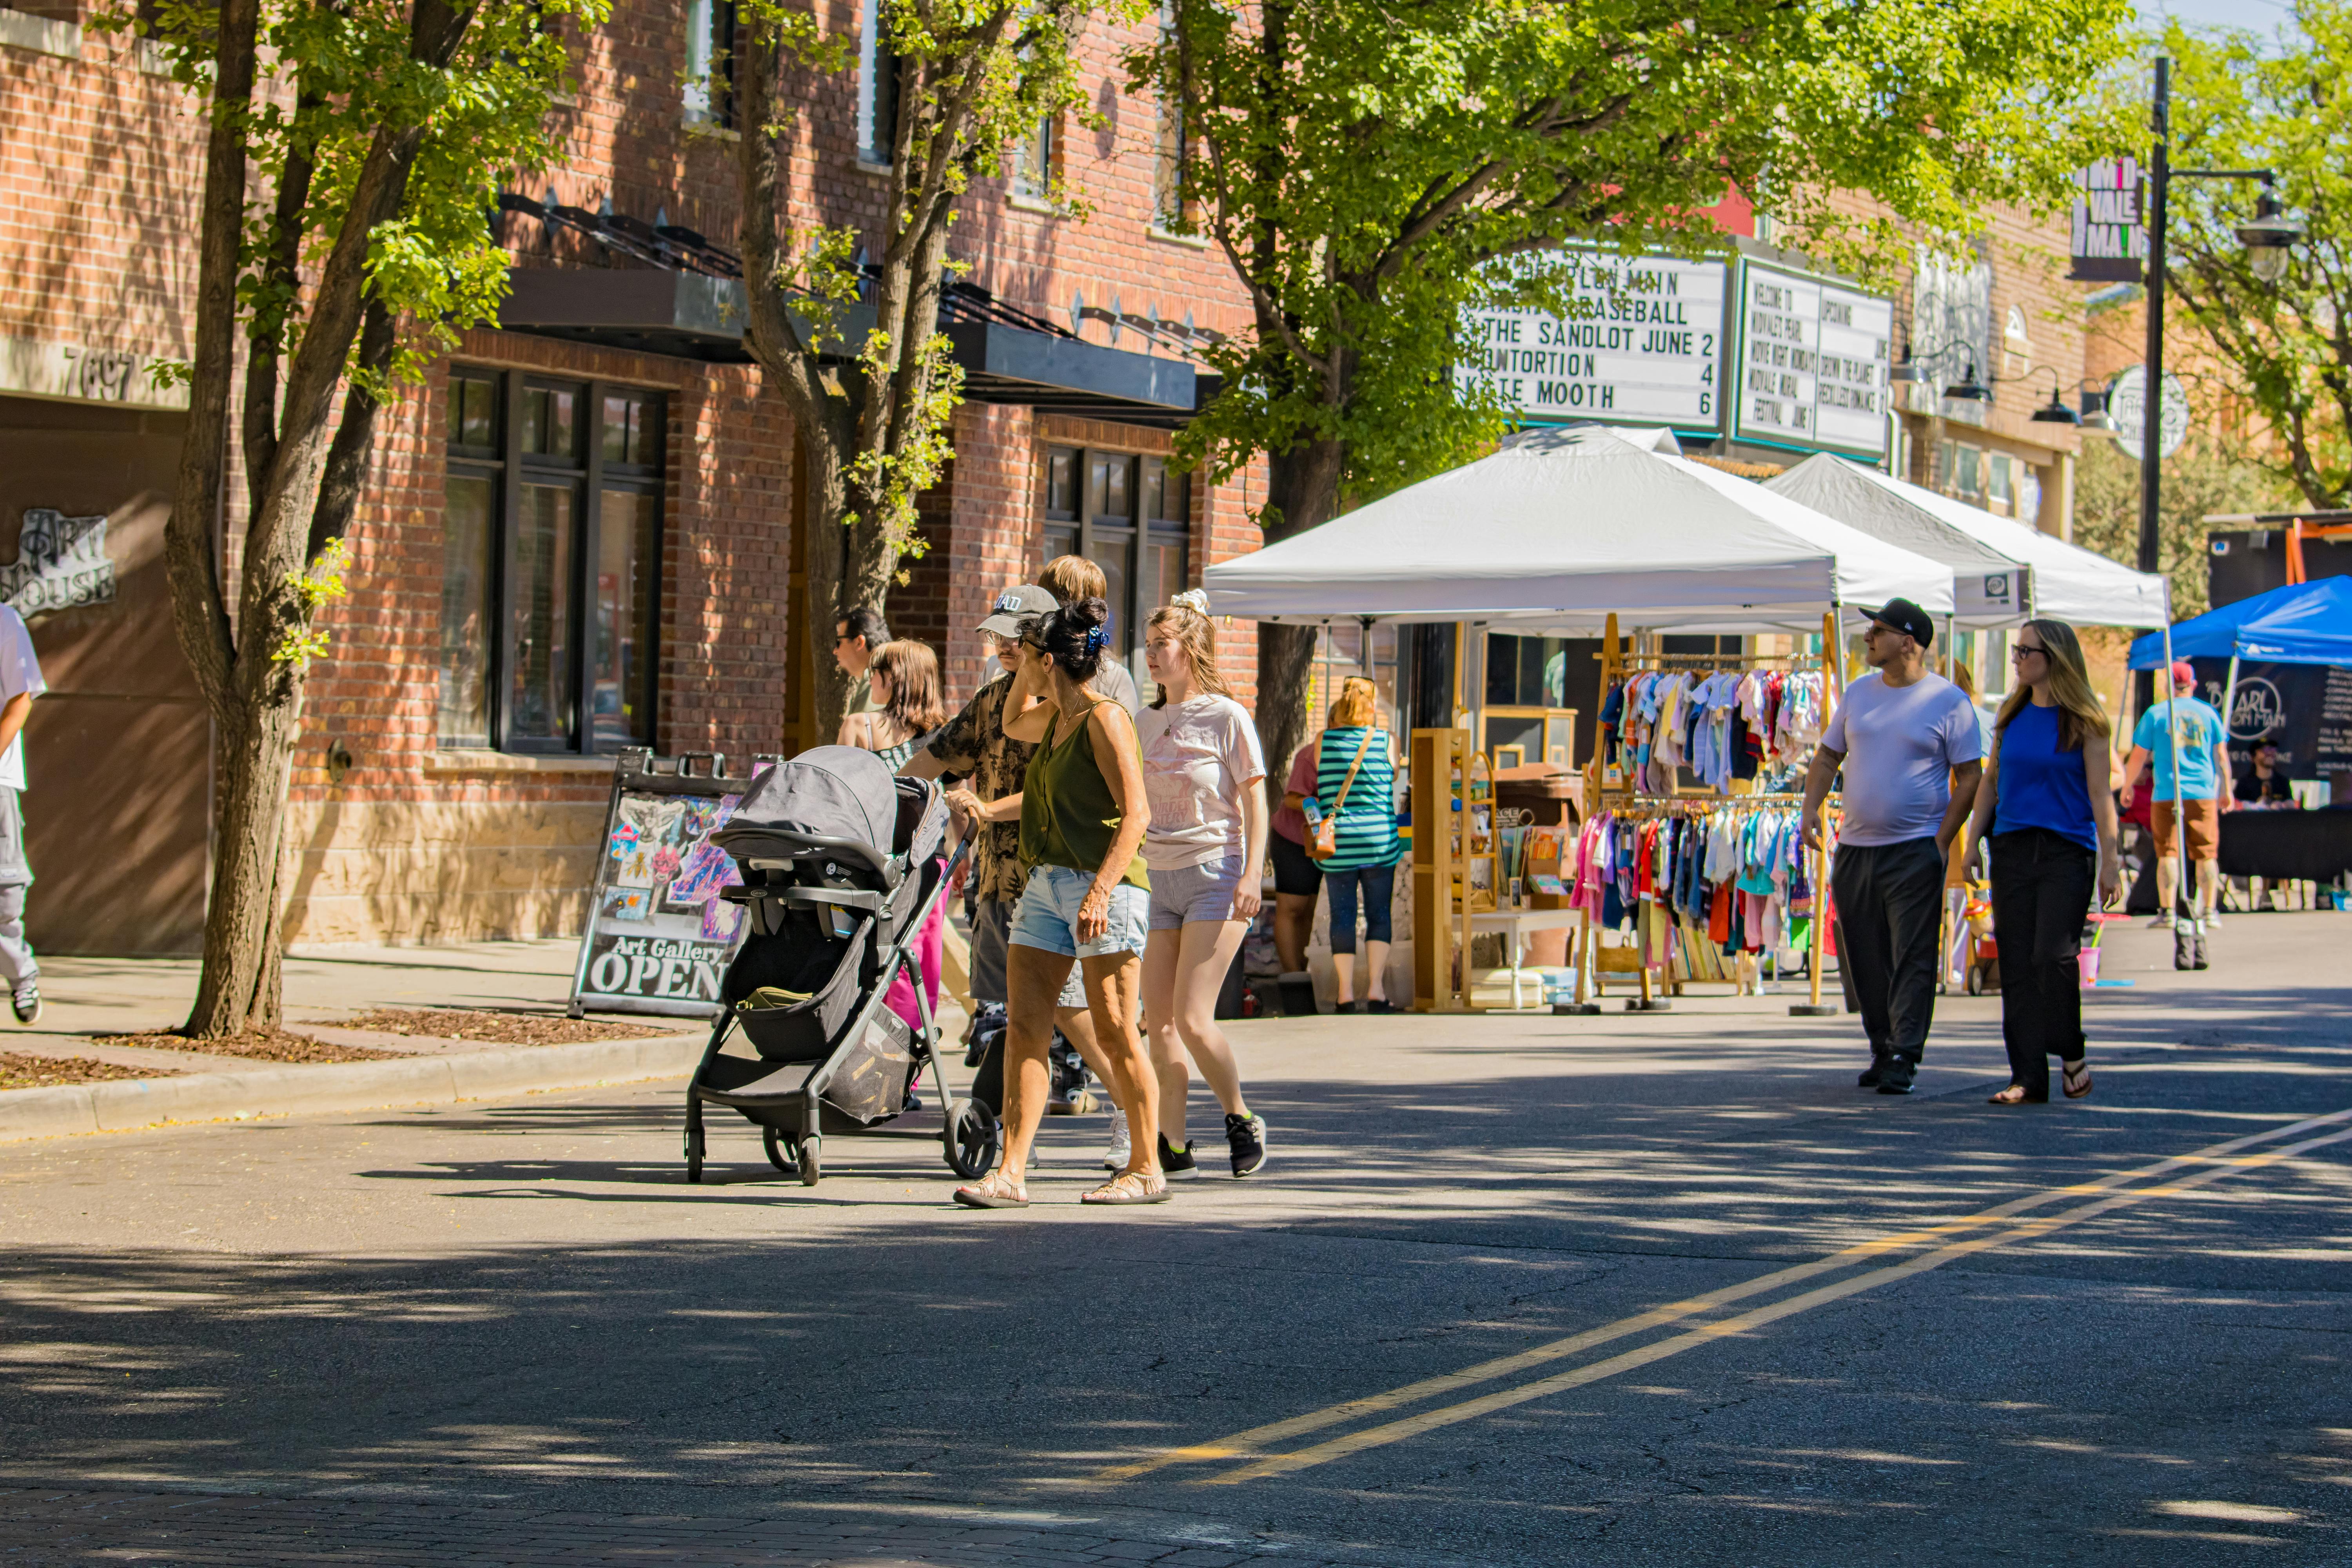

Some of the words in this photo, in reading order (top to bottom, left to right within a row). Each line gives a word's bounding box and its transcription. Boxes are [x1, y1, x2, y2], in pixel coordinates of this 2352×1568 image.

[2089, 191, 2137, 223] VALE
[1485, 318, 1521, 342] THE
[1539, 321, 1634, 350] SANDLOT
[1642, 330, 1692, 355] JUNE
[1702, 334, 1713, 356] 2
[1700, 363, 1713, 386] 4
[1537, 380, 1613, 408] MOOTH
[1700, 392, 1711, 415] 6
[1753, 398, 1782, 425] FESTIVAL
[21, 510, 105, 575] ART
[2210, 690, 2272, 713] PARL
[1151, 800, 1193, 815] URDER
[611, 936, 647, 955] Art
[650, 939, 724, 965] Gallery
[590, 952, 730, 1000] OPEN
